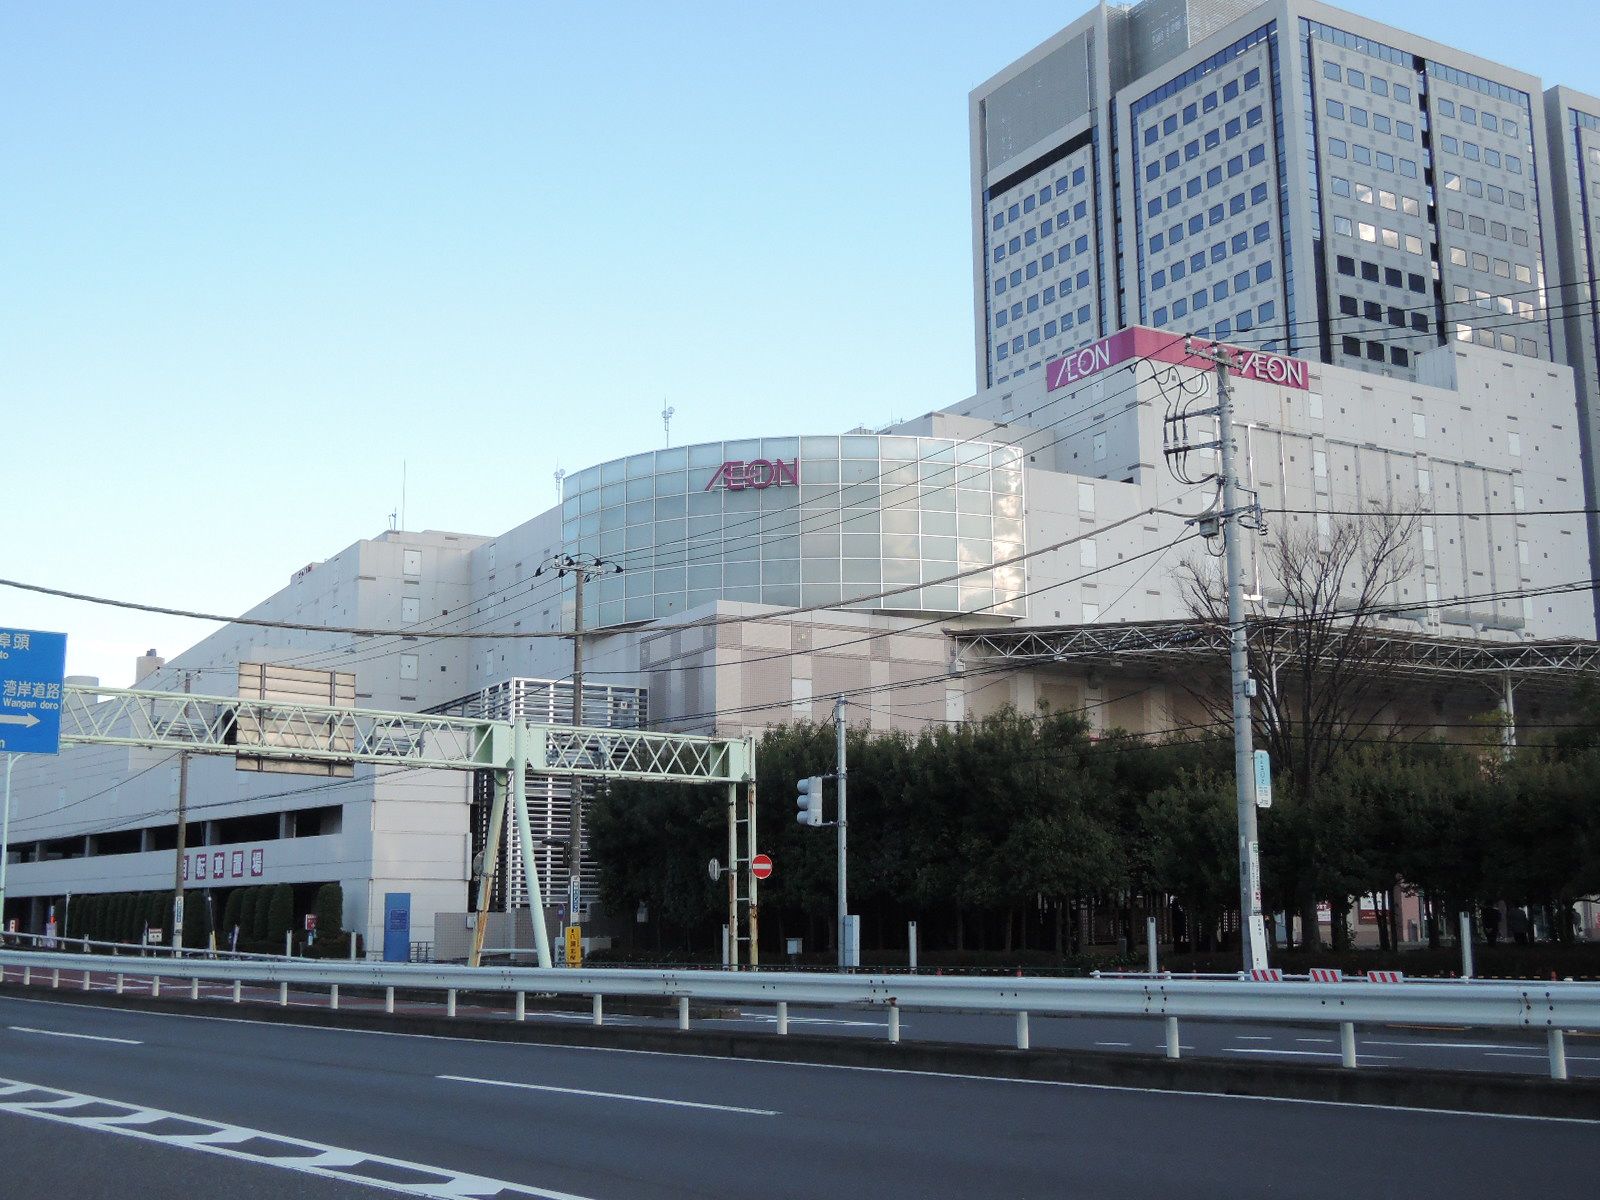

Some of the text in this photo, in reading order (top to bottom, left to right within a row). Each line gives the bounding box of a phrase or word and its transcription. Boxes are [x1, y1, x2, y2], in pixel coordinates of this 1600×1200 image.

[3, 679, 60, 699] 湾岸道路
[3, 697, 59, 710] Wangan doro
